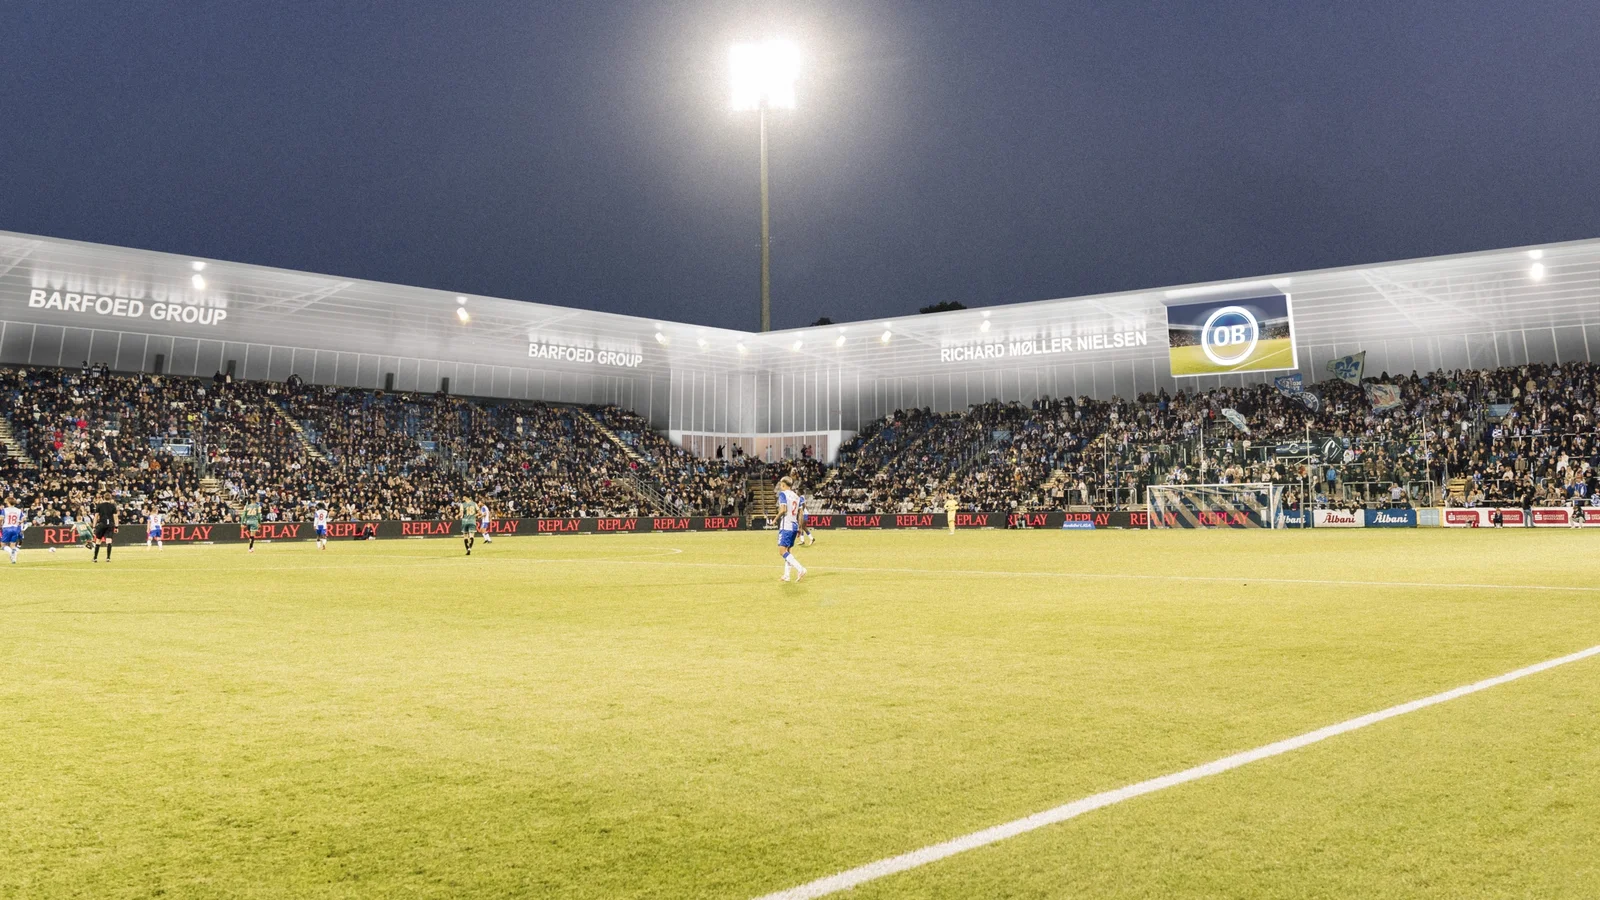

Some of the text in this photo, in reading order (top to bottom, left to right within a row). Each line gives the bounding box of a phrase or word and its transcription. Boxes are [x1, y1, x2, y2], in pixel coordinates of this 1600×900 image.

[28, 289, 227, 325] BARFOED GROUP
[1213, 325, 1246, 347] OB
[940, 331, 1147, 362] RICHARD MØLLER NIELSEN
[528, 343, 643, 367] BARFOED GROUP
[653, 518, 690, 530] REPLAY
[704, 517, 739, 529] REPLAY
[806, 515, 832, 527] EPLAY
[846, 515, 881, 526] REPLAY
[896, 515, 933, 526] REPLAY
[955, 514, 989, 526] EPLAY
[1008, 513, 1048, 526] RELAY
[1129, 512, 1178, 525] RELAY
[1198, 511, 1249, 525] REPLAY
[402, 522, 452, 535] REPLAY
[475, 520, 519, 533] RPLAY
[537, 519, 581, 532] REPLAY
[597, 519, 637, 531] REPLAY
[147, 526, 212, 541] EPLAY
